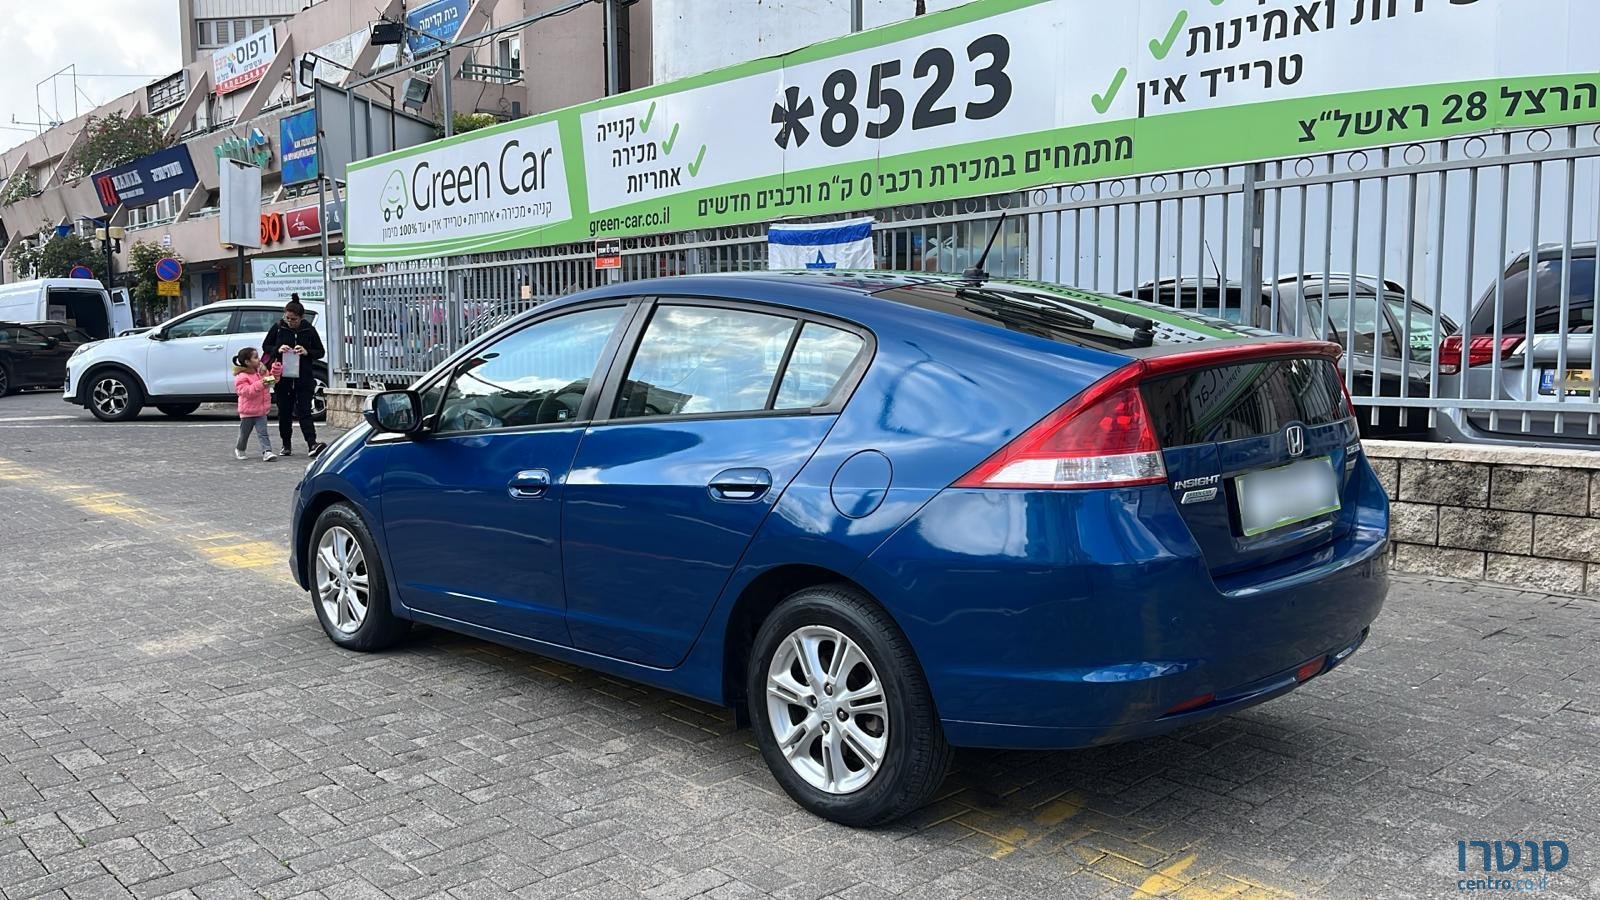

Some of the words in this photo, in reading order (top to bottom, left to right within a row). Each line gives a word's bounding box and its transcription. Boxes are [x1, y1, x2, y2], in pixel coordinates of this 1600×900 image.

[419, 12, 442, 31] קדימה
[444, 6, 459, 21] בית
[1185, 0, 1336, 57] ואמינות
[236, 34, 267, 65] דפוס
[1200, 53, 1303, 98] טרייד
[1137, 74, 1188, 118] אין
[1441, 91, 1488, 124] 28
[1500, 82, 1597, 117] הרצל
[597, 117, 635, 142] קנייה
[1298, 103, 1429, 143] ראשל"צ
[612, 142, 657, 167] מכירה
[1023, 134, 1133, 174] מתמחים
[412, 160, 491, 212] Green
[499, 139, 552, 196] Car
[627, 167, 681, 193] אחריות
[930, 152, 1016, 186] במכירת
[818, 172, 853, 203] ק"מ
[860, 172, 872, 196] 0
[878, 170, 923, 195] רכבי
[532, 201, 552, 218] קניה
[698, 191, 750, 217] חדשים
[756, 184, 811, 210] ורכבים
[443, 214, 462, 228] טרייד
[467, 209, 495, 225] אחריות
[501, 205, 526, 219] מכירה
[589, 206, 670, 237] green-car.co.il
[382, 225, 398, 242] מימון
[399, 222, 418, 236] 100%
[417, 222, 427, 233] עד
[431, 218, 442, 234] אין
[279, 261, 313, 273] Green
[1174, 474, 1221, 490] INSIGHT
